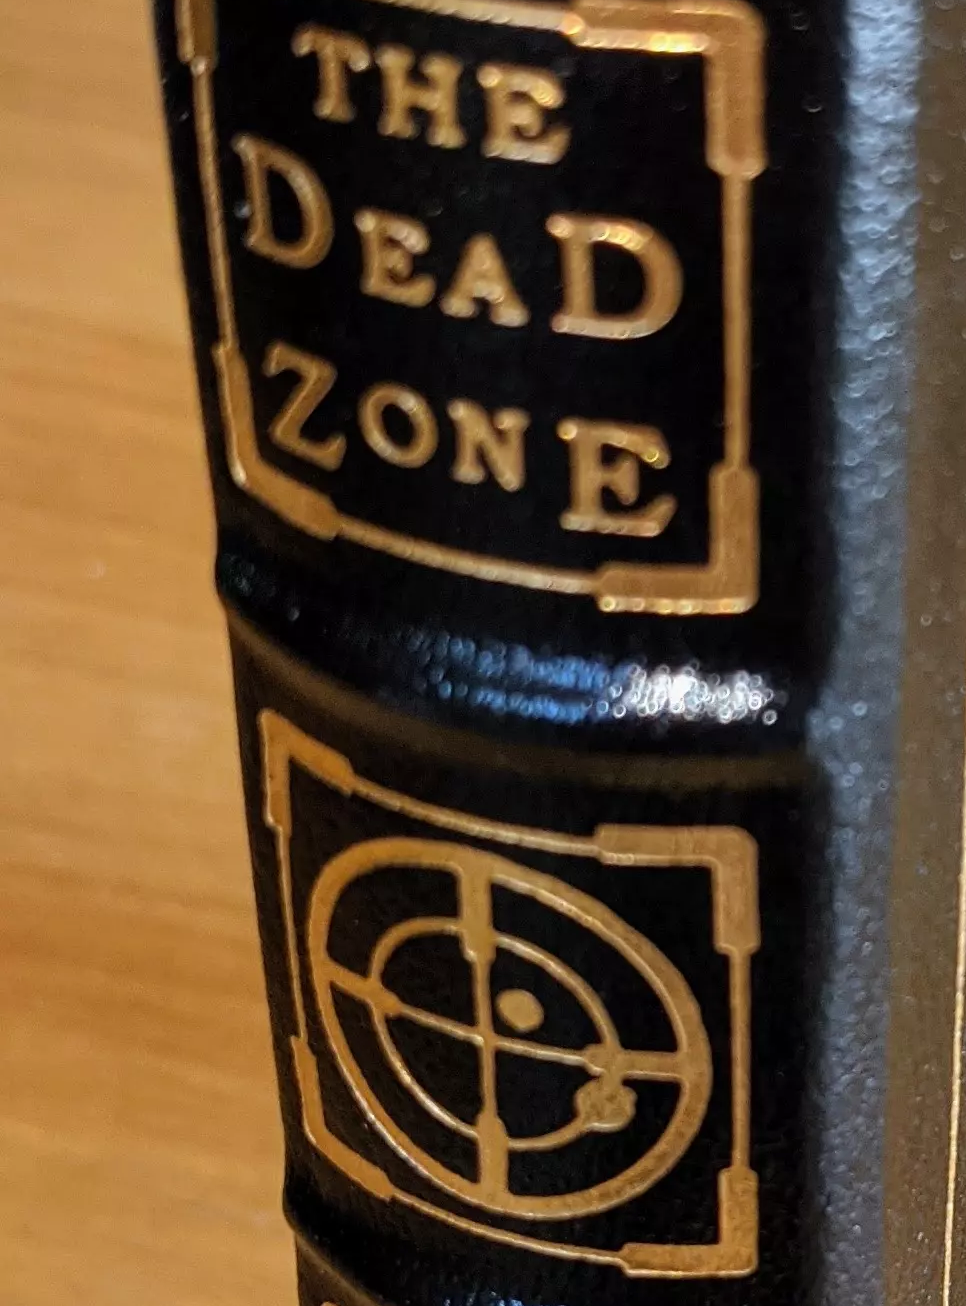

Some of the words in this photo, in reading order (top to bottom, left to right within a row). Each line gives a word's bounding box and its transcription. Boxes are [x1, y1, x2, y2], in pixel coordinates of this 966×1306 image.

[293, 26, 571, 164] THE
[231, 133, 683, 339] DEAD
[263, 342, 677, 536] ZONE
